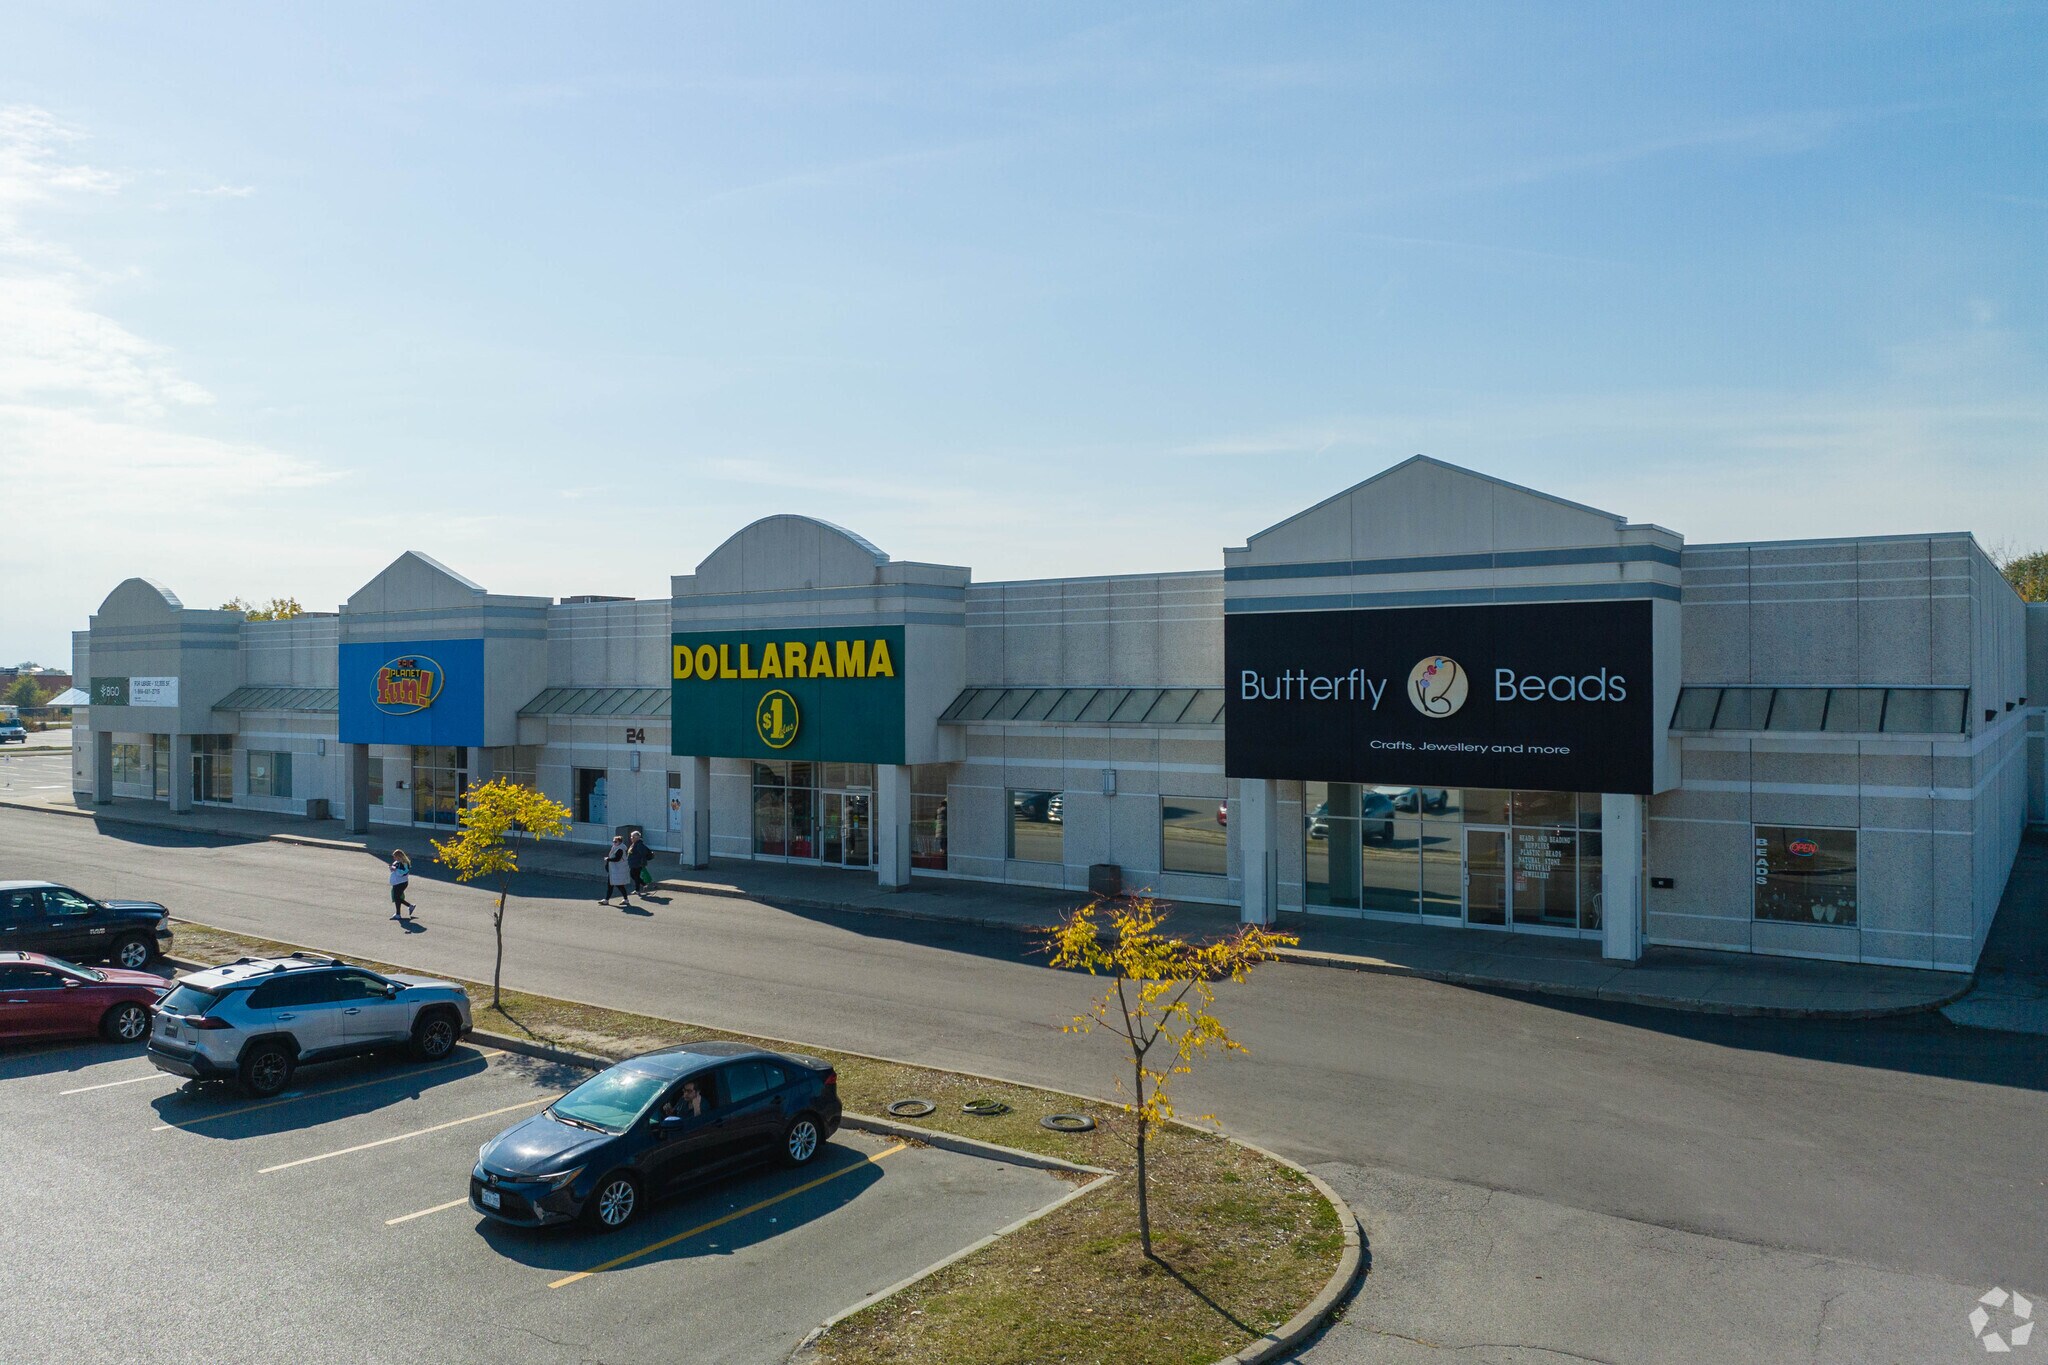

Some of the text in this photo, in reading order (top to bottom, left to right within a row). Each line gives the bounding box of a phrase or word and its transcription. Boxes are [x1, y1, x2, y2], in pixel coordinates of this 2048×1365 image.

[673, 639, 894, 680] DOLLARAMA
[391, 669, 420, 677] PLANET
[106, 686, 120, 696] BGO
[377, 667, 434, 708] fun!
[1241, 667, 1627, 710] Butterfly Beads
[626, 728, 645, 743] 24
[1370, 740, 1571, 755] Crafts, Jewellery and more
[1790, 843, 1816, 853] OPEN
[1756, 838, 1769, 885] BEADS
[1522, 871, 1550, 879] JEWELLERY
